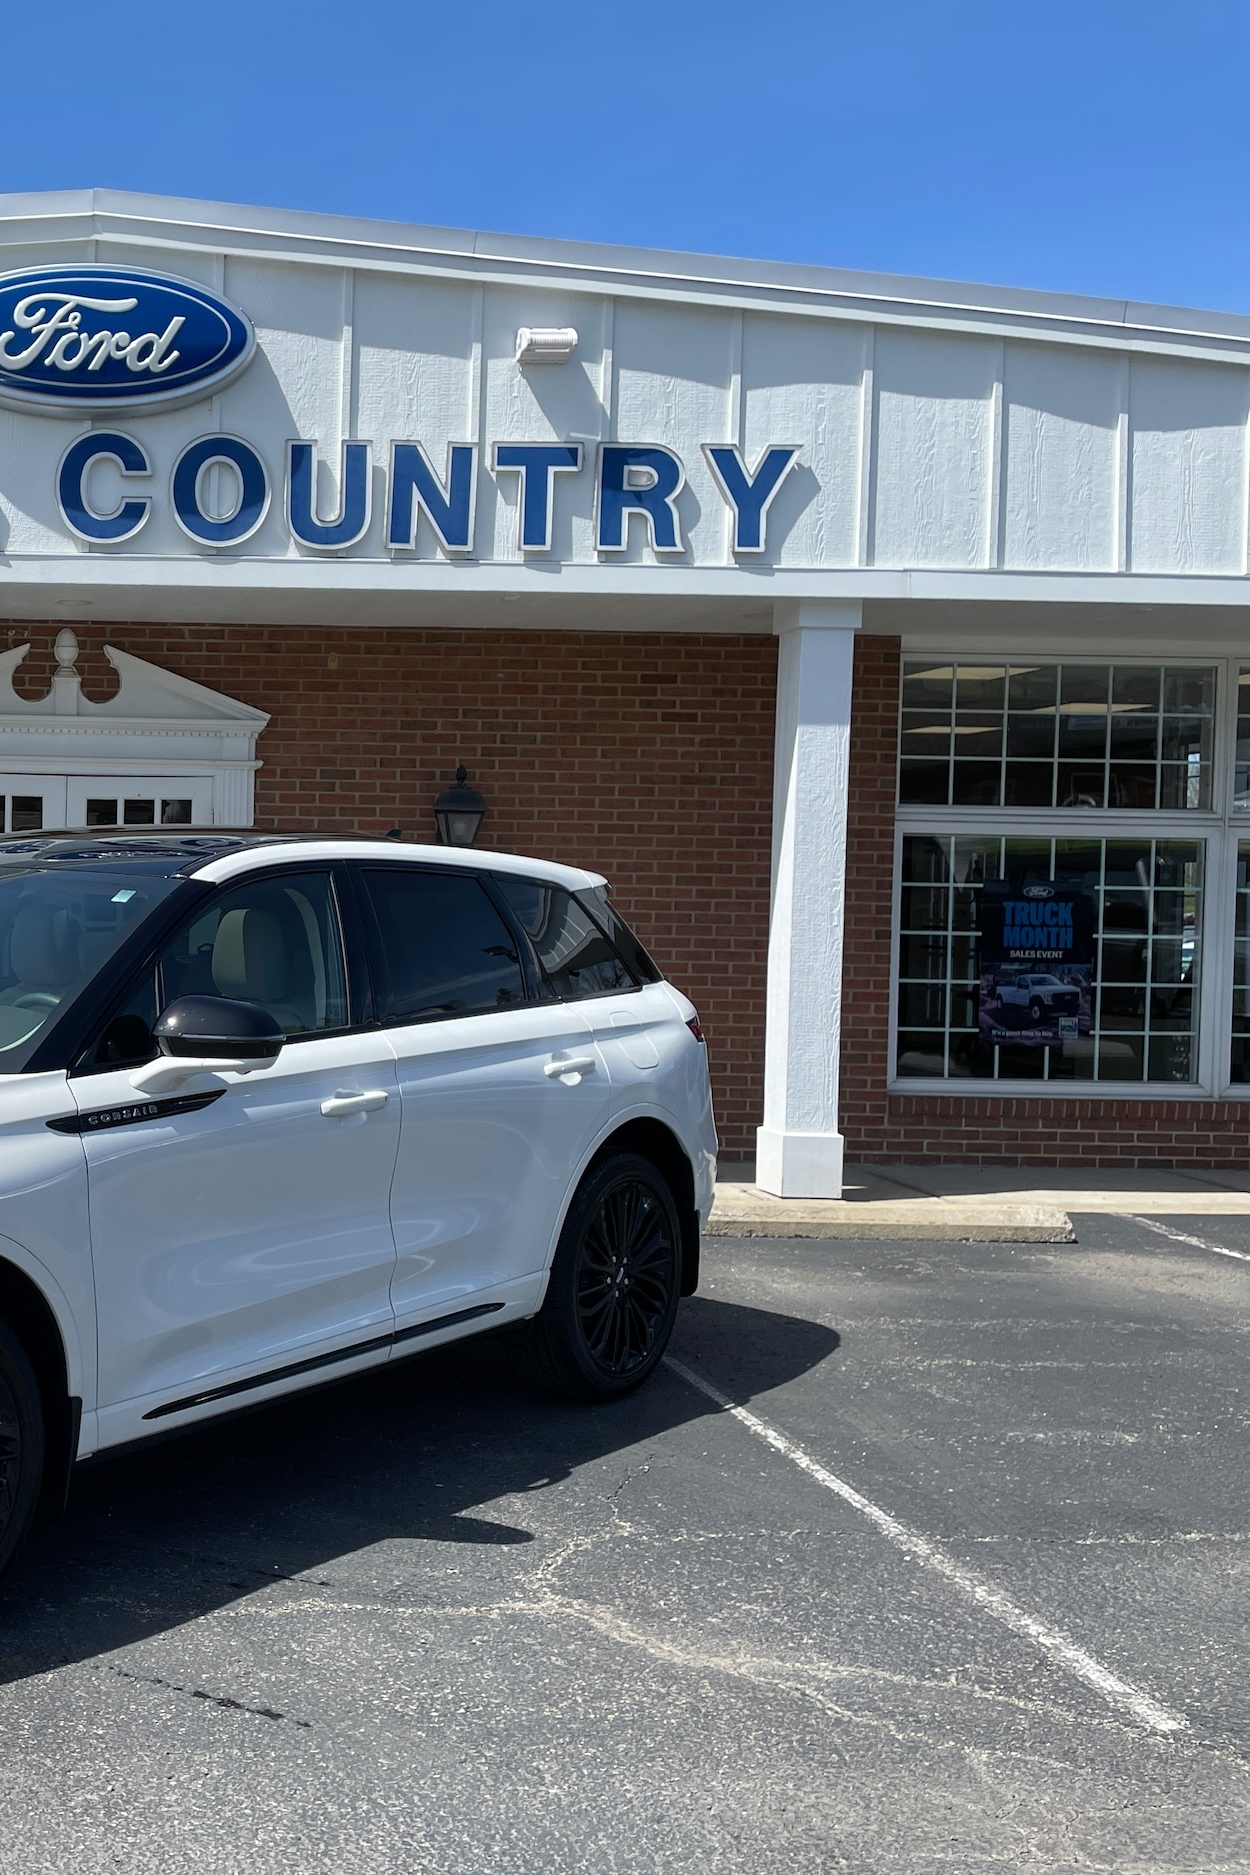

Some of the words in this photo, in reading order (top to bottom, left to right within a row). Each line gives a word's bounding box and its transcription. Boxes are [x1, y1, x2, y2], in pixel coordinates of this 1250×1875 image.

[55, 428, 804, 554] COUNTRY
[1002, 901, 1074, 926] TRUCK
[1002, 926, 1073, 949] MONTH
[1010, 950, 1036, 959] SALES
[1037, 950, 1064, 959] EVENT
[88, 1105, 158, 1125] CORSAIR
